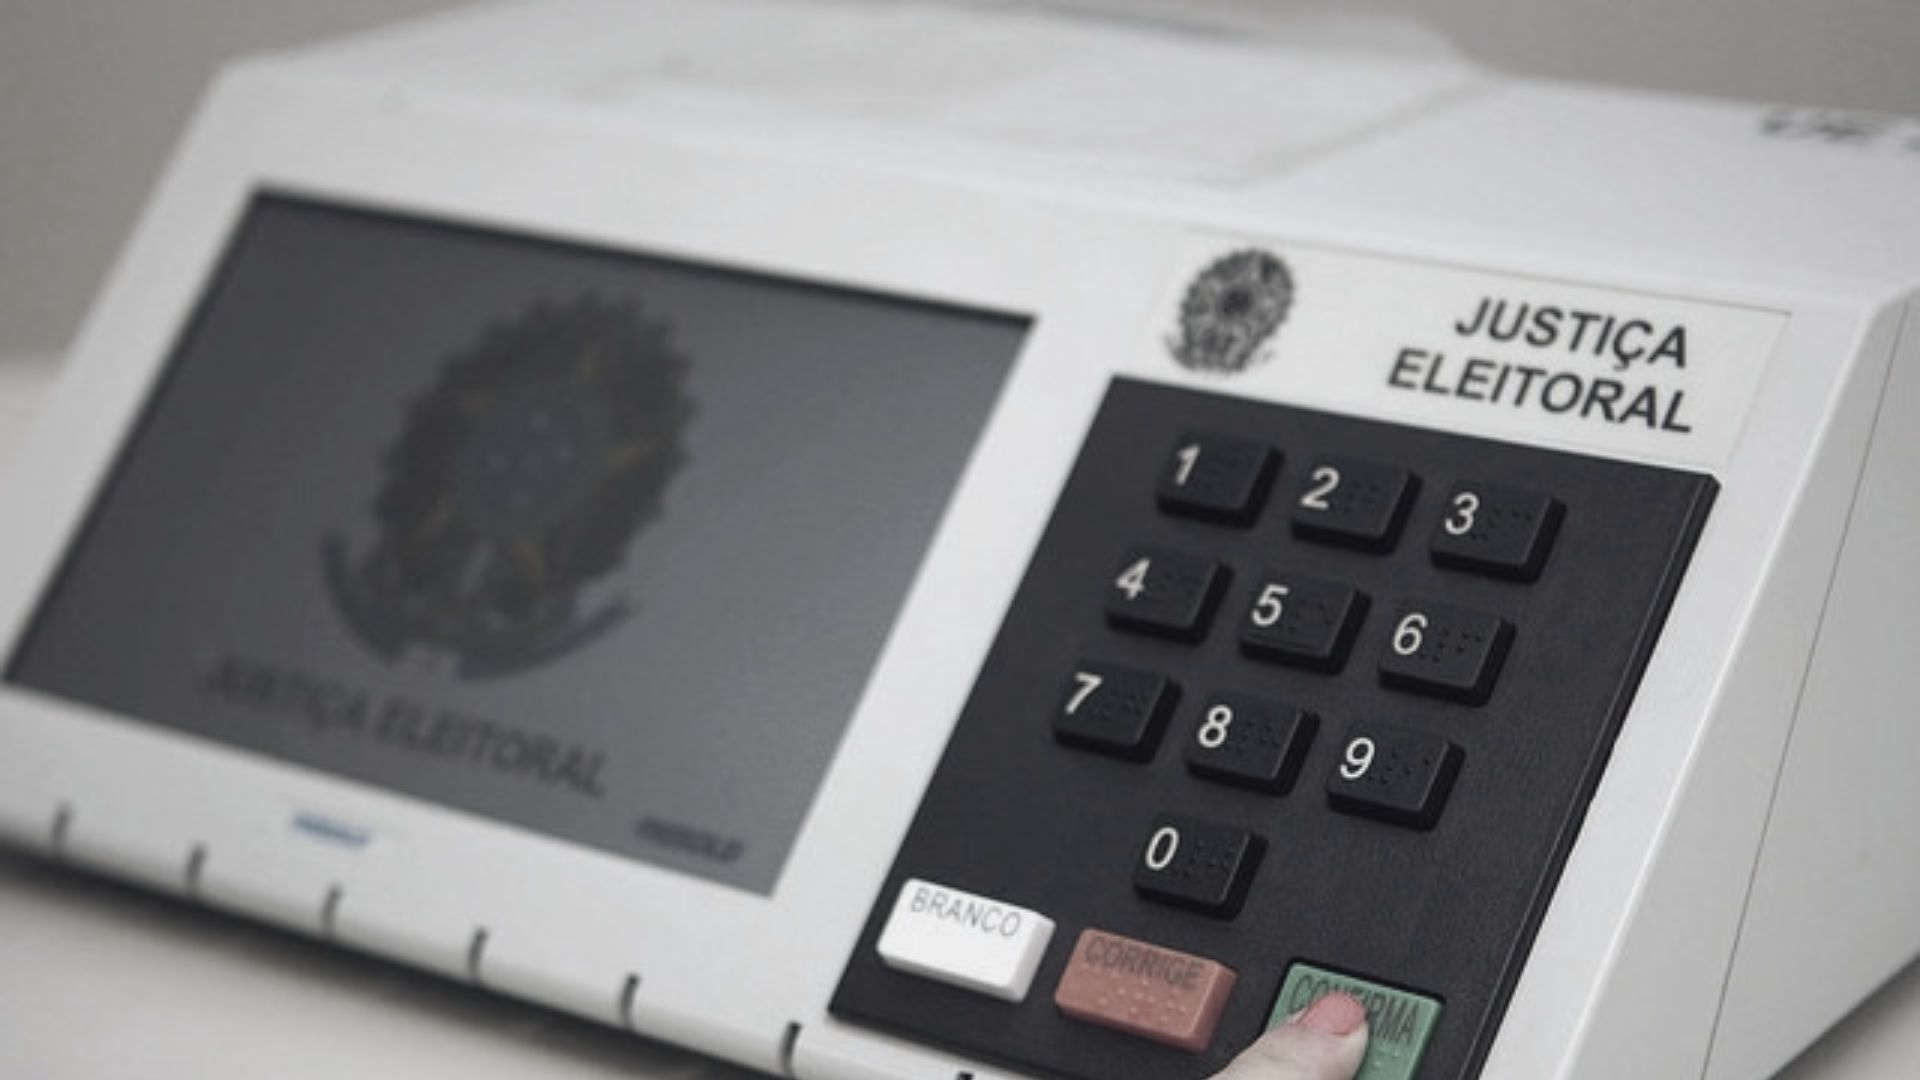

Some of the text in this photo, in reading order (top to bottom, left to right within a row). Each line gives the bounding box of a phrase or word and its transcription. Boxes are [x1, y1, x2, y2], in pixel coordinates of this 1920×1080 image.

[1454, 297, 1687, 371] JUSTIÇA
[1387, 347, 1692, 434] ELEITORAL
[1176, 445, 1200, 485] 1
[1301, 467, 1340, 509] 2
[1445, 492, 1480, 535] 3
[1116, 558, 1150, 599] 4
[1252, 584, 1289, 626] 5
[1393, 613, 1428, 655] 6
[1065, 672, 1102, 714] 7
[1198, 704, 1233, 748] 8
[1339, 737, 1375, 780] 9
[1145, 826, 1179, 870] 0
[911, 886, 1021, 937] BRANCO
[1085, 936, 1202, 992] CORRIGE
[1289, 974, 1420, 1046] CRMA
